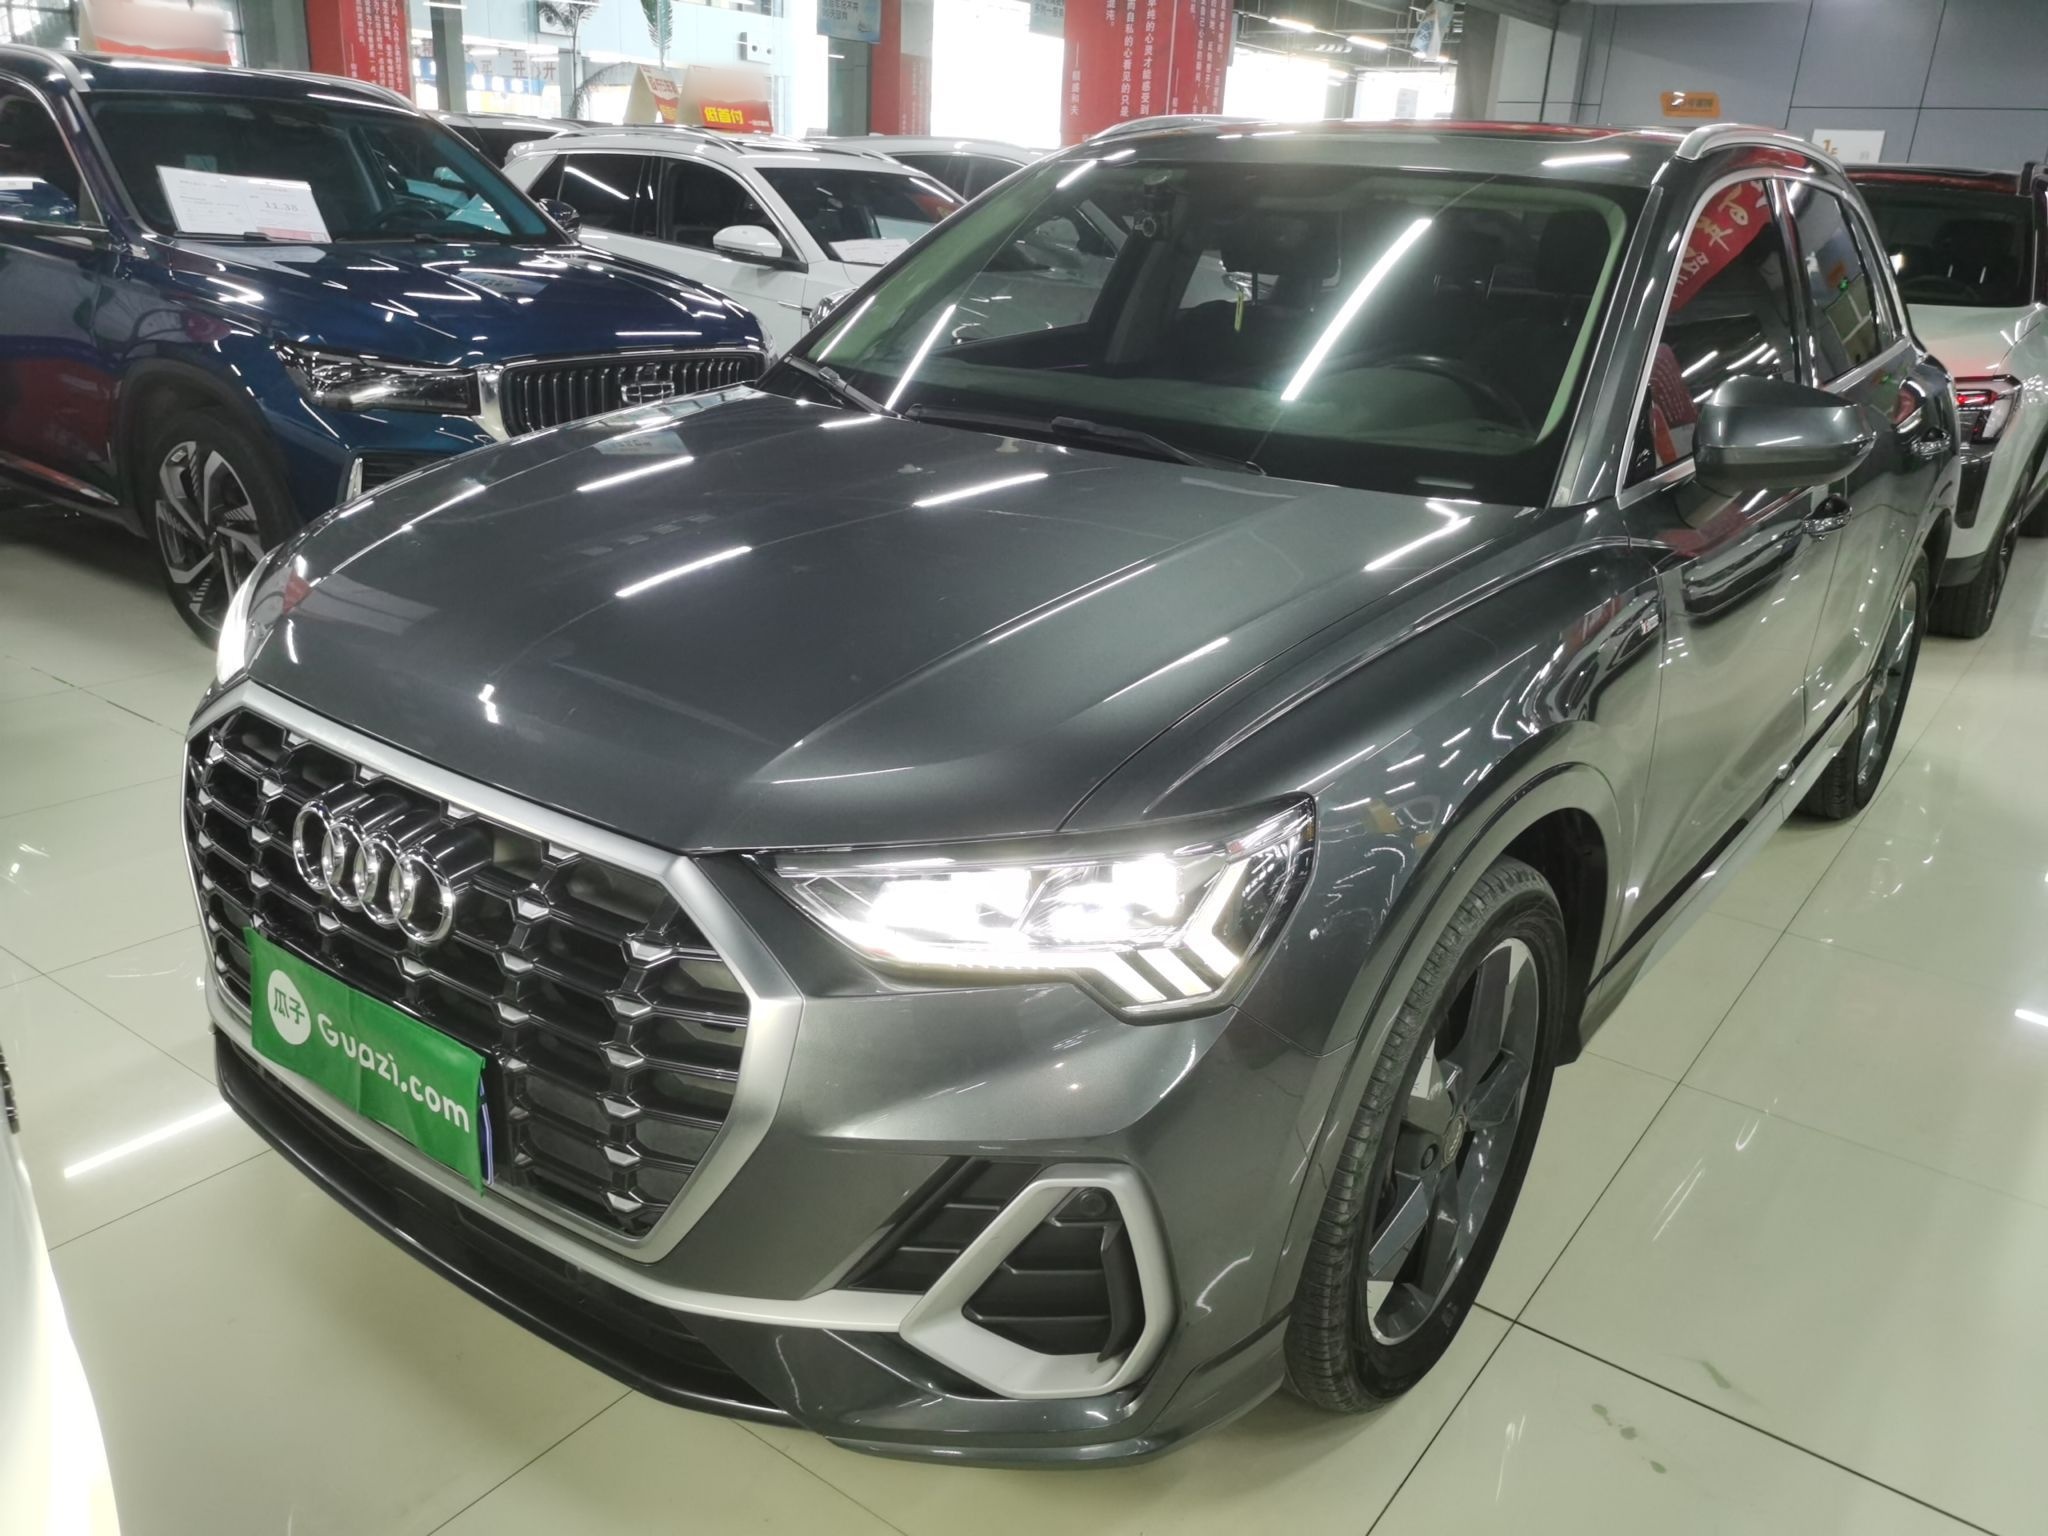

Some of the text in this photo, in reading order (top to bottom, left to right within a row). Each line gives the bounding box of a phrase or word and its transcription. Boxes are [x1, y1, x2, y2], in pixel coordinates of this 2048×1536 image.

[704, 106, 744, 124] 低首付
[273, 987, 305, 1025] 瓜子
[317, 1012, 470, 1134] Guazi.com
